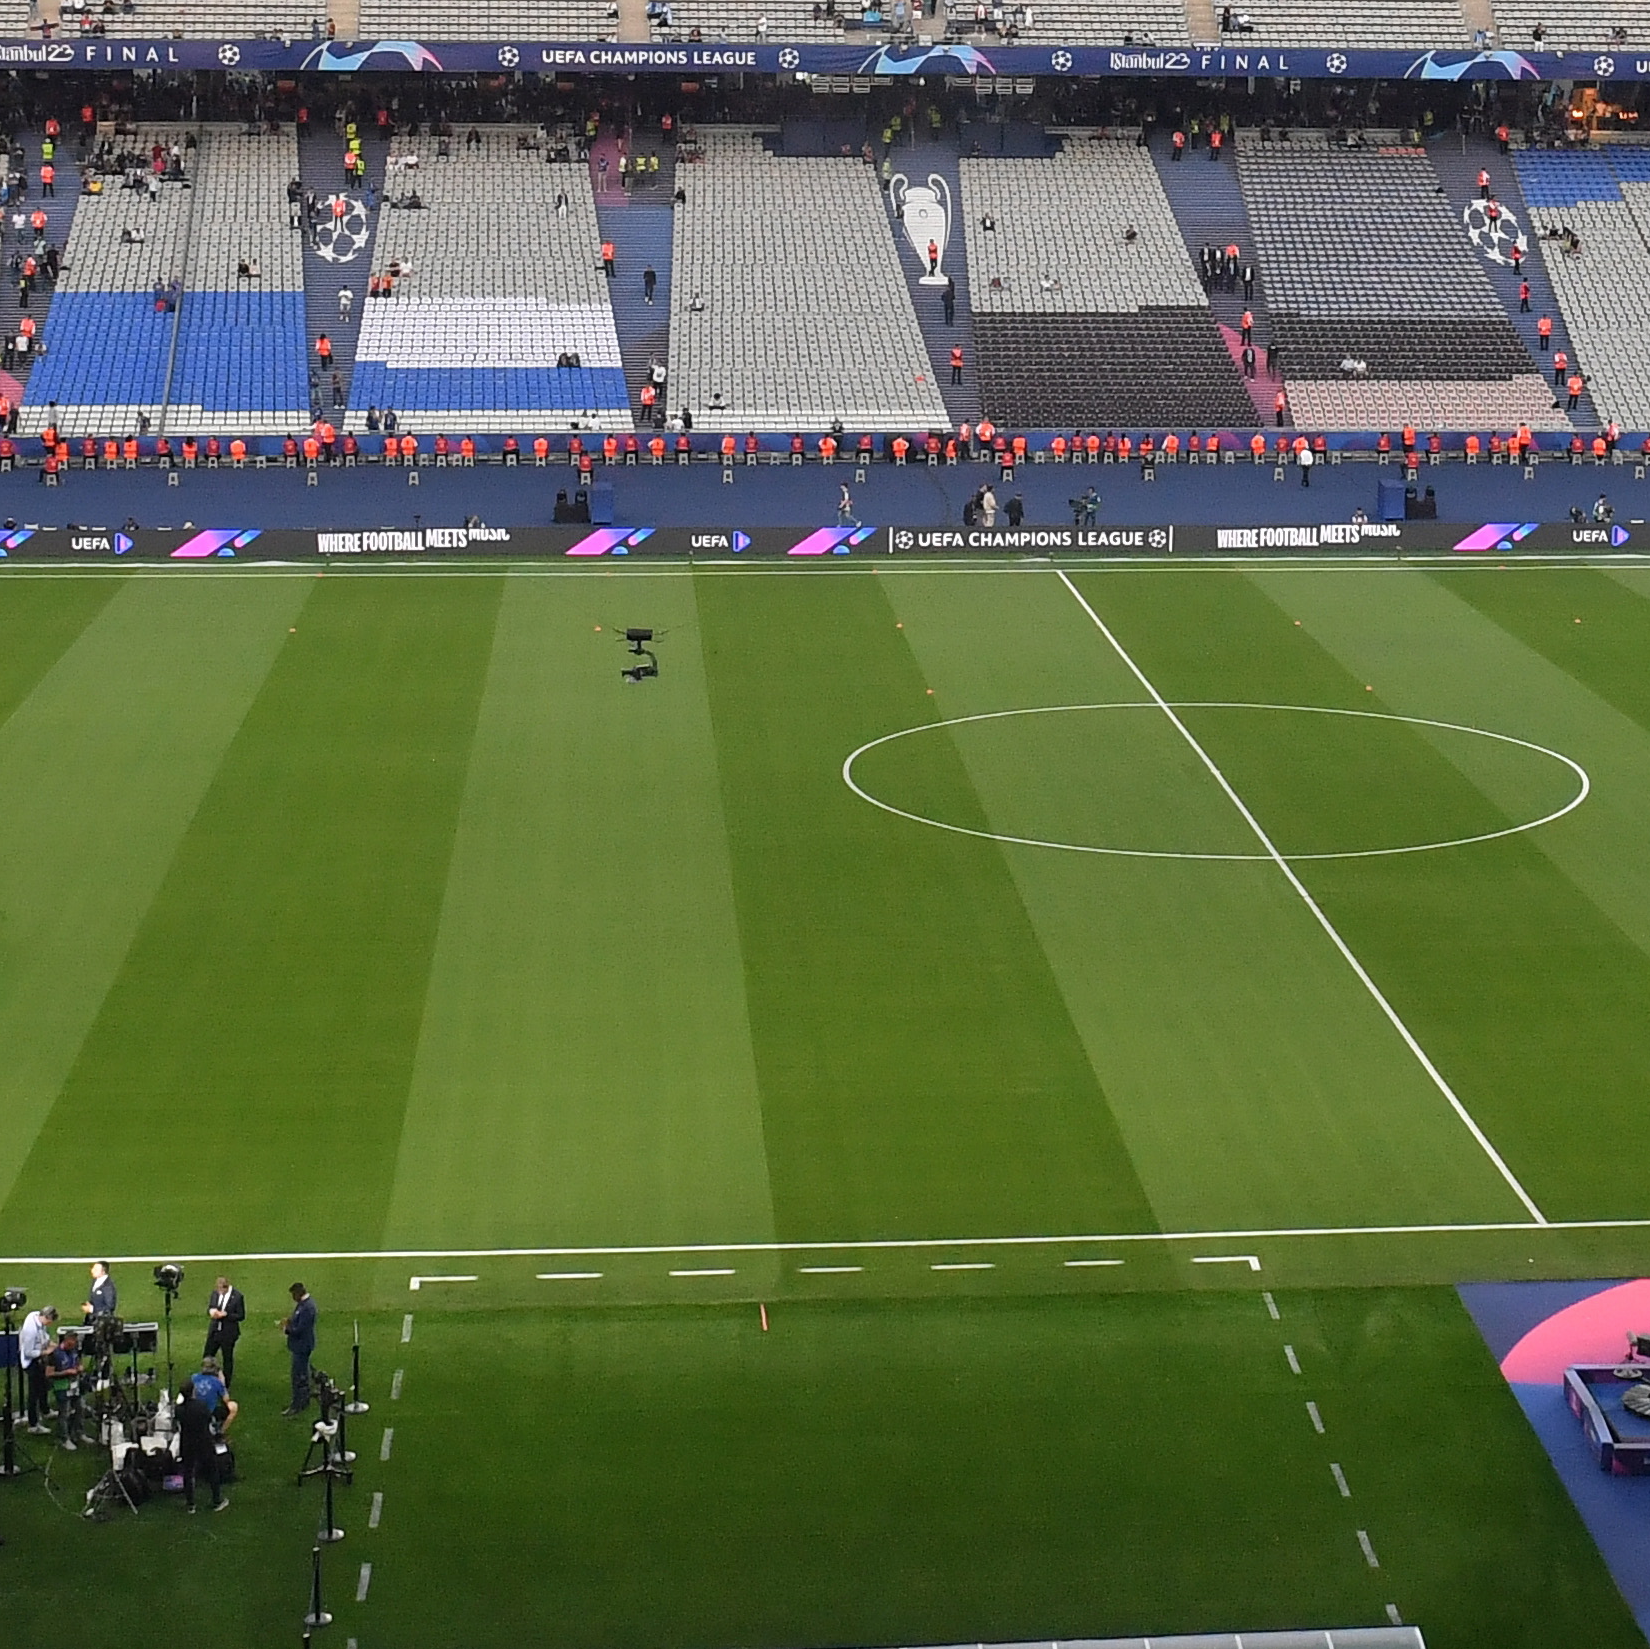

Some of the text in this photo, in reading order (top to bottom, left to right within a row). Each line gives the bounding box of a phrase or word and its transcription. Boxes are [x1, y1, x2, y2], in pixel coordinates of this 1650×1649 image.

[87, 46, 178, 62] FINAL
[543, 50, 755, 64] UEFA CHAMPIONS LEAGUE
[1202, 55, 1288, 69] FINAL
[318, 533, 361, 552] WHERE
[363, 532, 425, 551] FOOTBALL
[426, 529, 467, 547] MEETS
[692, 535, 728, 547] UEFA
[919, 532, 1143, 546] UEFA CHAMPIONS LEAGUE
[1217, 529, 1258, 548] WHERE
[1260, 528, 1319, 546] FOOTBALL
[1320, 525, 1359, 543] MEETS
[1573, 530, 1608, 542] UEFA
[72, 538, 110, 549] UEFA
